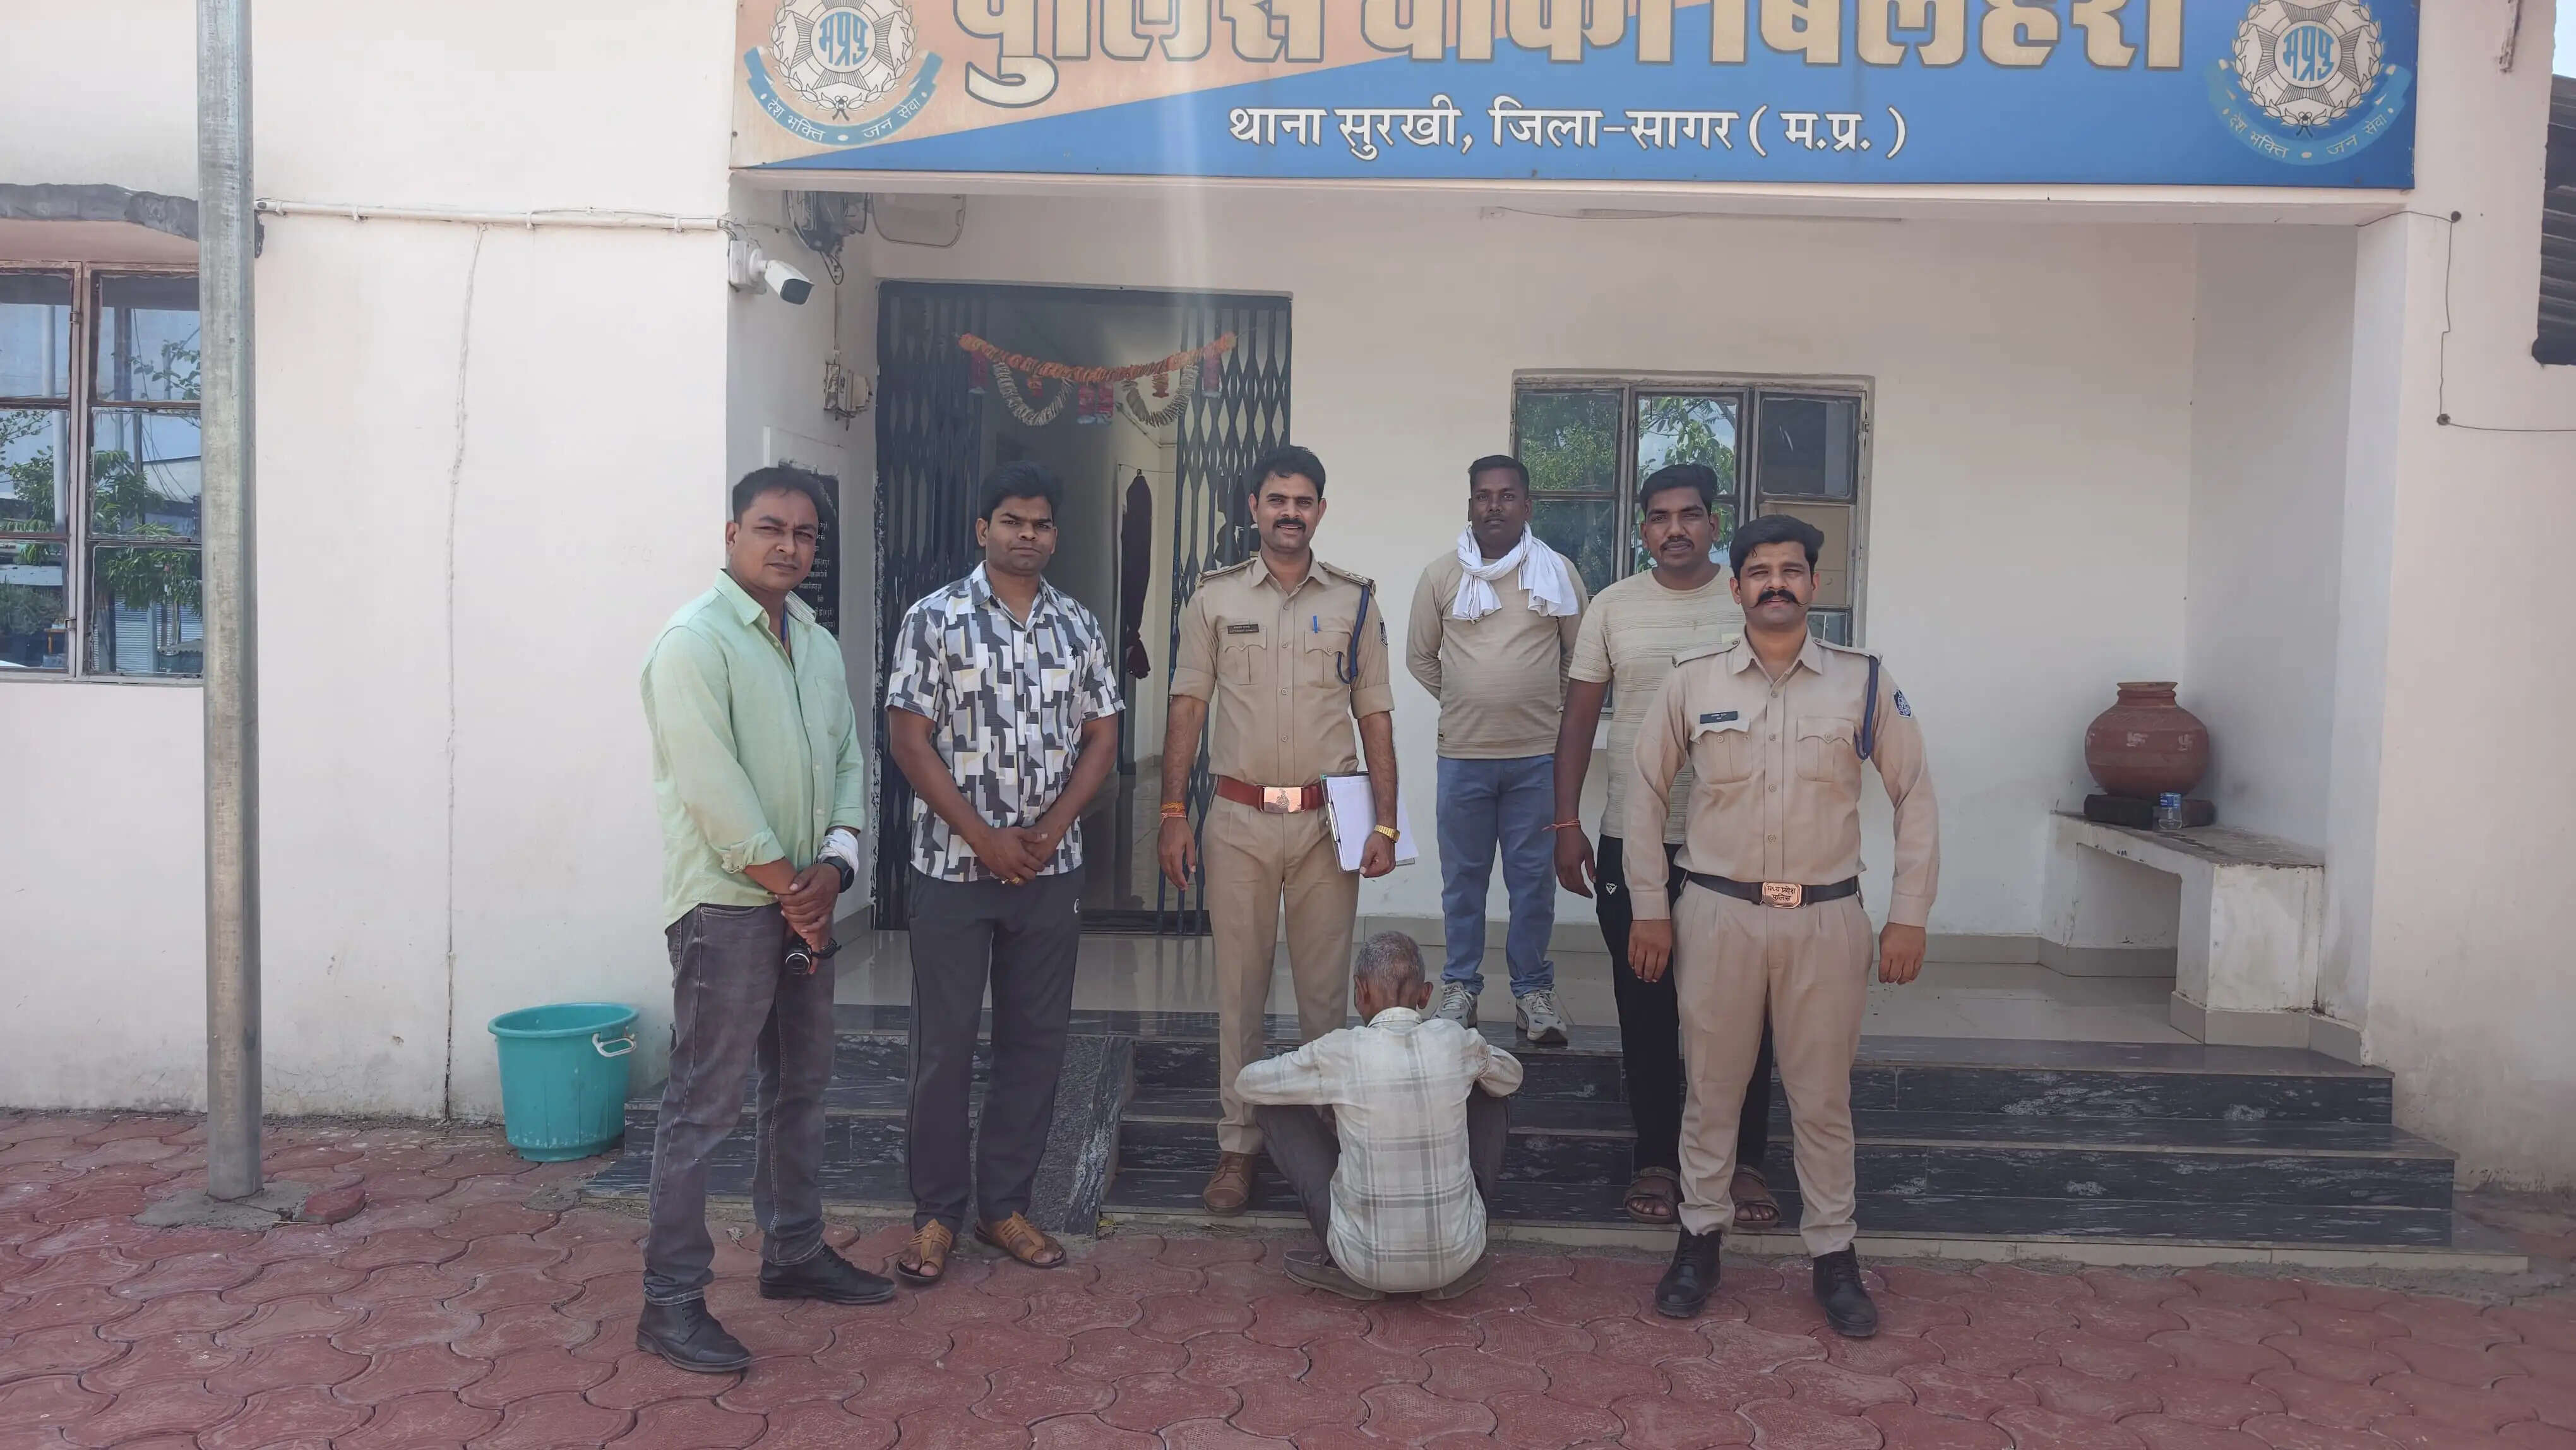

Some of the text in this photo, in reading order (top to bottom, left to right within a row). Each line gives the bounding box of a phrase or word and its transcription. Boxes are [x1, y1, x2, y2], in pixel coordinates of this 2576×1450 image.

[767, 97, 921, 142] देश भक्ति जन सेवा
[1229, 107, 1329, 146] थाना
[2326, 135, 2358, 155] जन
[1772, 893, 1792, 901] पुलिस
[1781, 885, 1797, 895] प्रदेश
